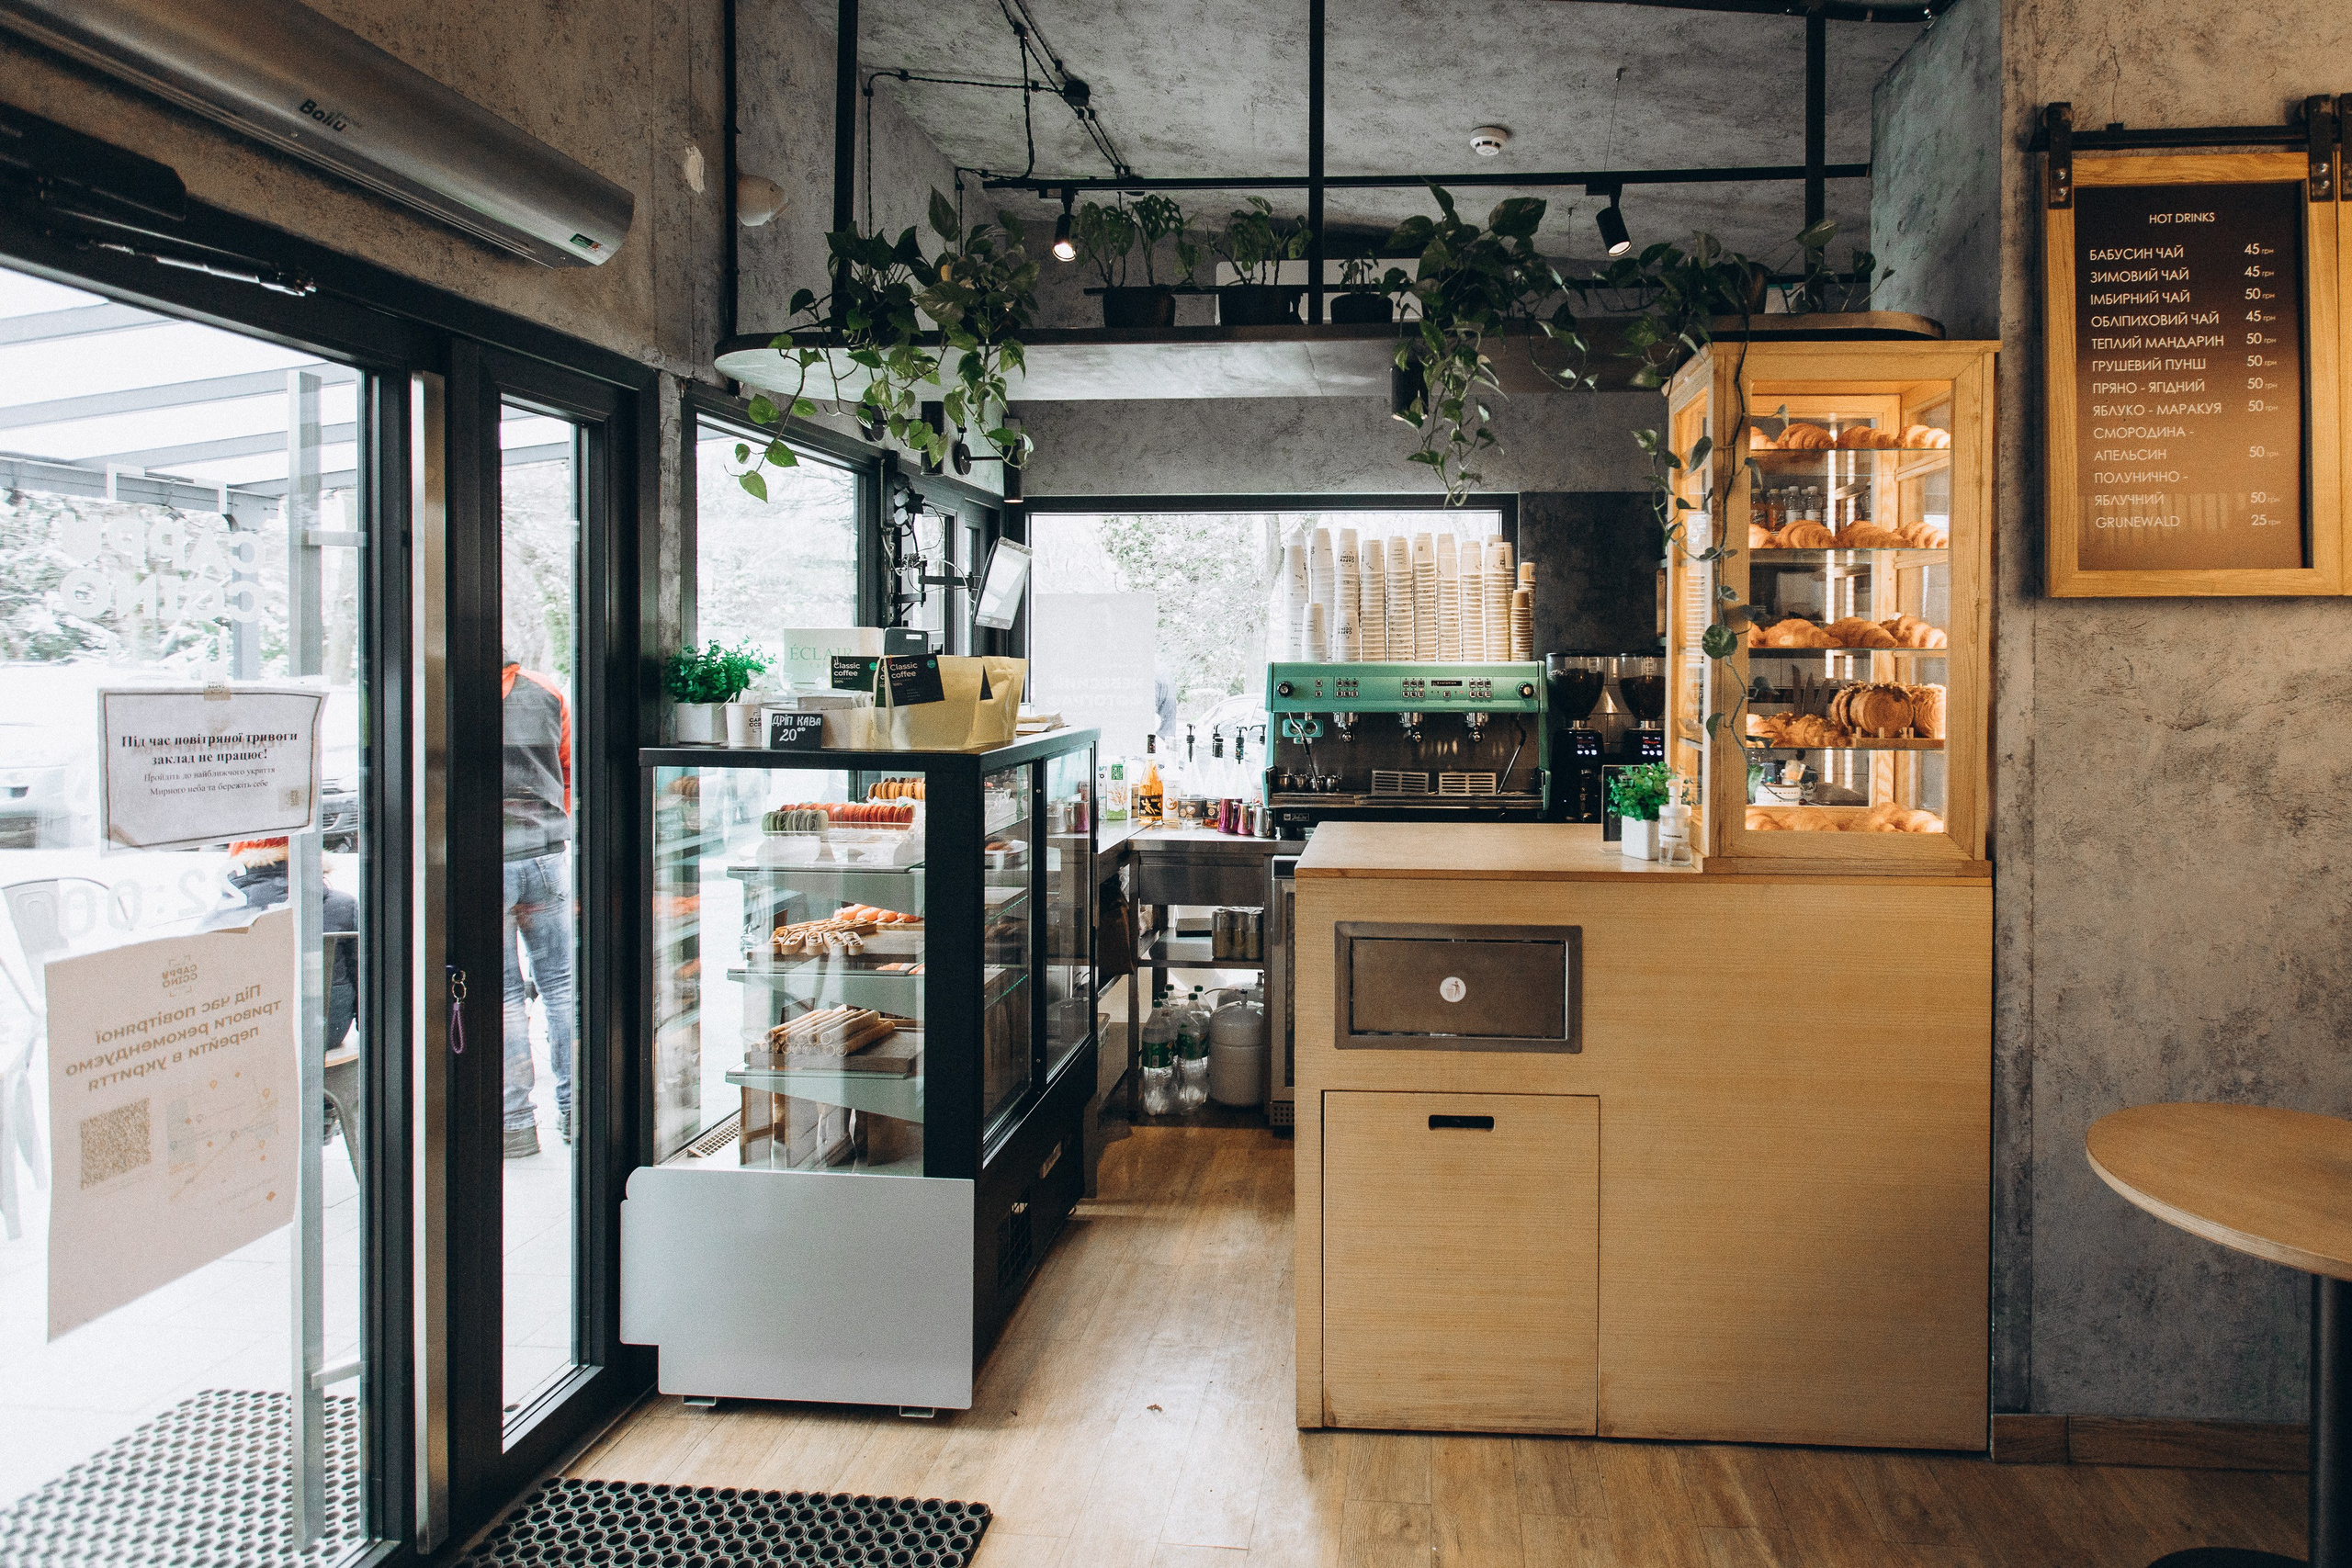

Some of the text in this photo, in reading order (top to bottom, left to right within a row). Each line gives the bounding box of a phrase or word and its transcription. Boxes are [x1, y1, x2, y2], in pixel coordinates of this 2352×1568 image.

[2149, 212, 2215, 223] HOT DRINKS
[2089, 244, 2184, 261] БАБУСИН ЧАЙ
[2245, 243, 2259, 254] 45
[2090, 267, 2189, 284] ЗИМОВИЙ ЧАЙ
[2245, 265, 2259, 277] 45
[2090, 289, 2190, 305] ІМБИРНИЙ ЧАЙ
[2245, 288, 2260, 299] 50
[2091, 310, 2219, 328] ОБЛІПИХОВИЙ ЧАЙ
[2245, 310, 2261, 321] 45
[2091, 335, 2224, 350] ТЕПЛИЙ МАНДАРИН
[2246, 333, 2262, 344] 50
[2092, 357, 2206, 372] ГРУШЕВИЙ ПУНШ
[2247, 355, 2263, 367] 50
[2093, 382, 2137, 394] ПРЯНО
[2149, 379, 2205, 394] ЯГІДНИЙ
[2247, 378, 2263, 389] 50
[2093, 405, 2144, 416] ЯБЛУКО
[2157, 402, 2222, 414] МАРАКУЯ
[2248, 400, 2264, 412] 50
[2094, 427, 2186, 439] СМОРОДИНА
[2094, 449, 2166, 461] АПЕЛЬСИН
[2249, 446, 2265, 457] 50
[2095, 471, 2179, 483] ПОЛУНИЧНО
[2095, 492, 2165, 506] ЯБЛУЧНИЙ
[2251, 492, 2266, 503] 50
[2096, 516, 2180, 528] GRUNEWALD
[2251, 515, 2267, 526] 25
[890, 662, 917, 671] Classic
[891, 671, 917, 679] coffee
[797, 716, 820, 727] КАВА
[121, 736, 145, 748] Під
[150, 737, 170, 746] час
[175, 732, 243, 747] повітряної
[245, 733, 298, 743] тривоги
[152, 749, 267, 765] заклад не працює!
[150, 786, 186, 796] Мирного
[188, 784, 205, 793] неба
